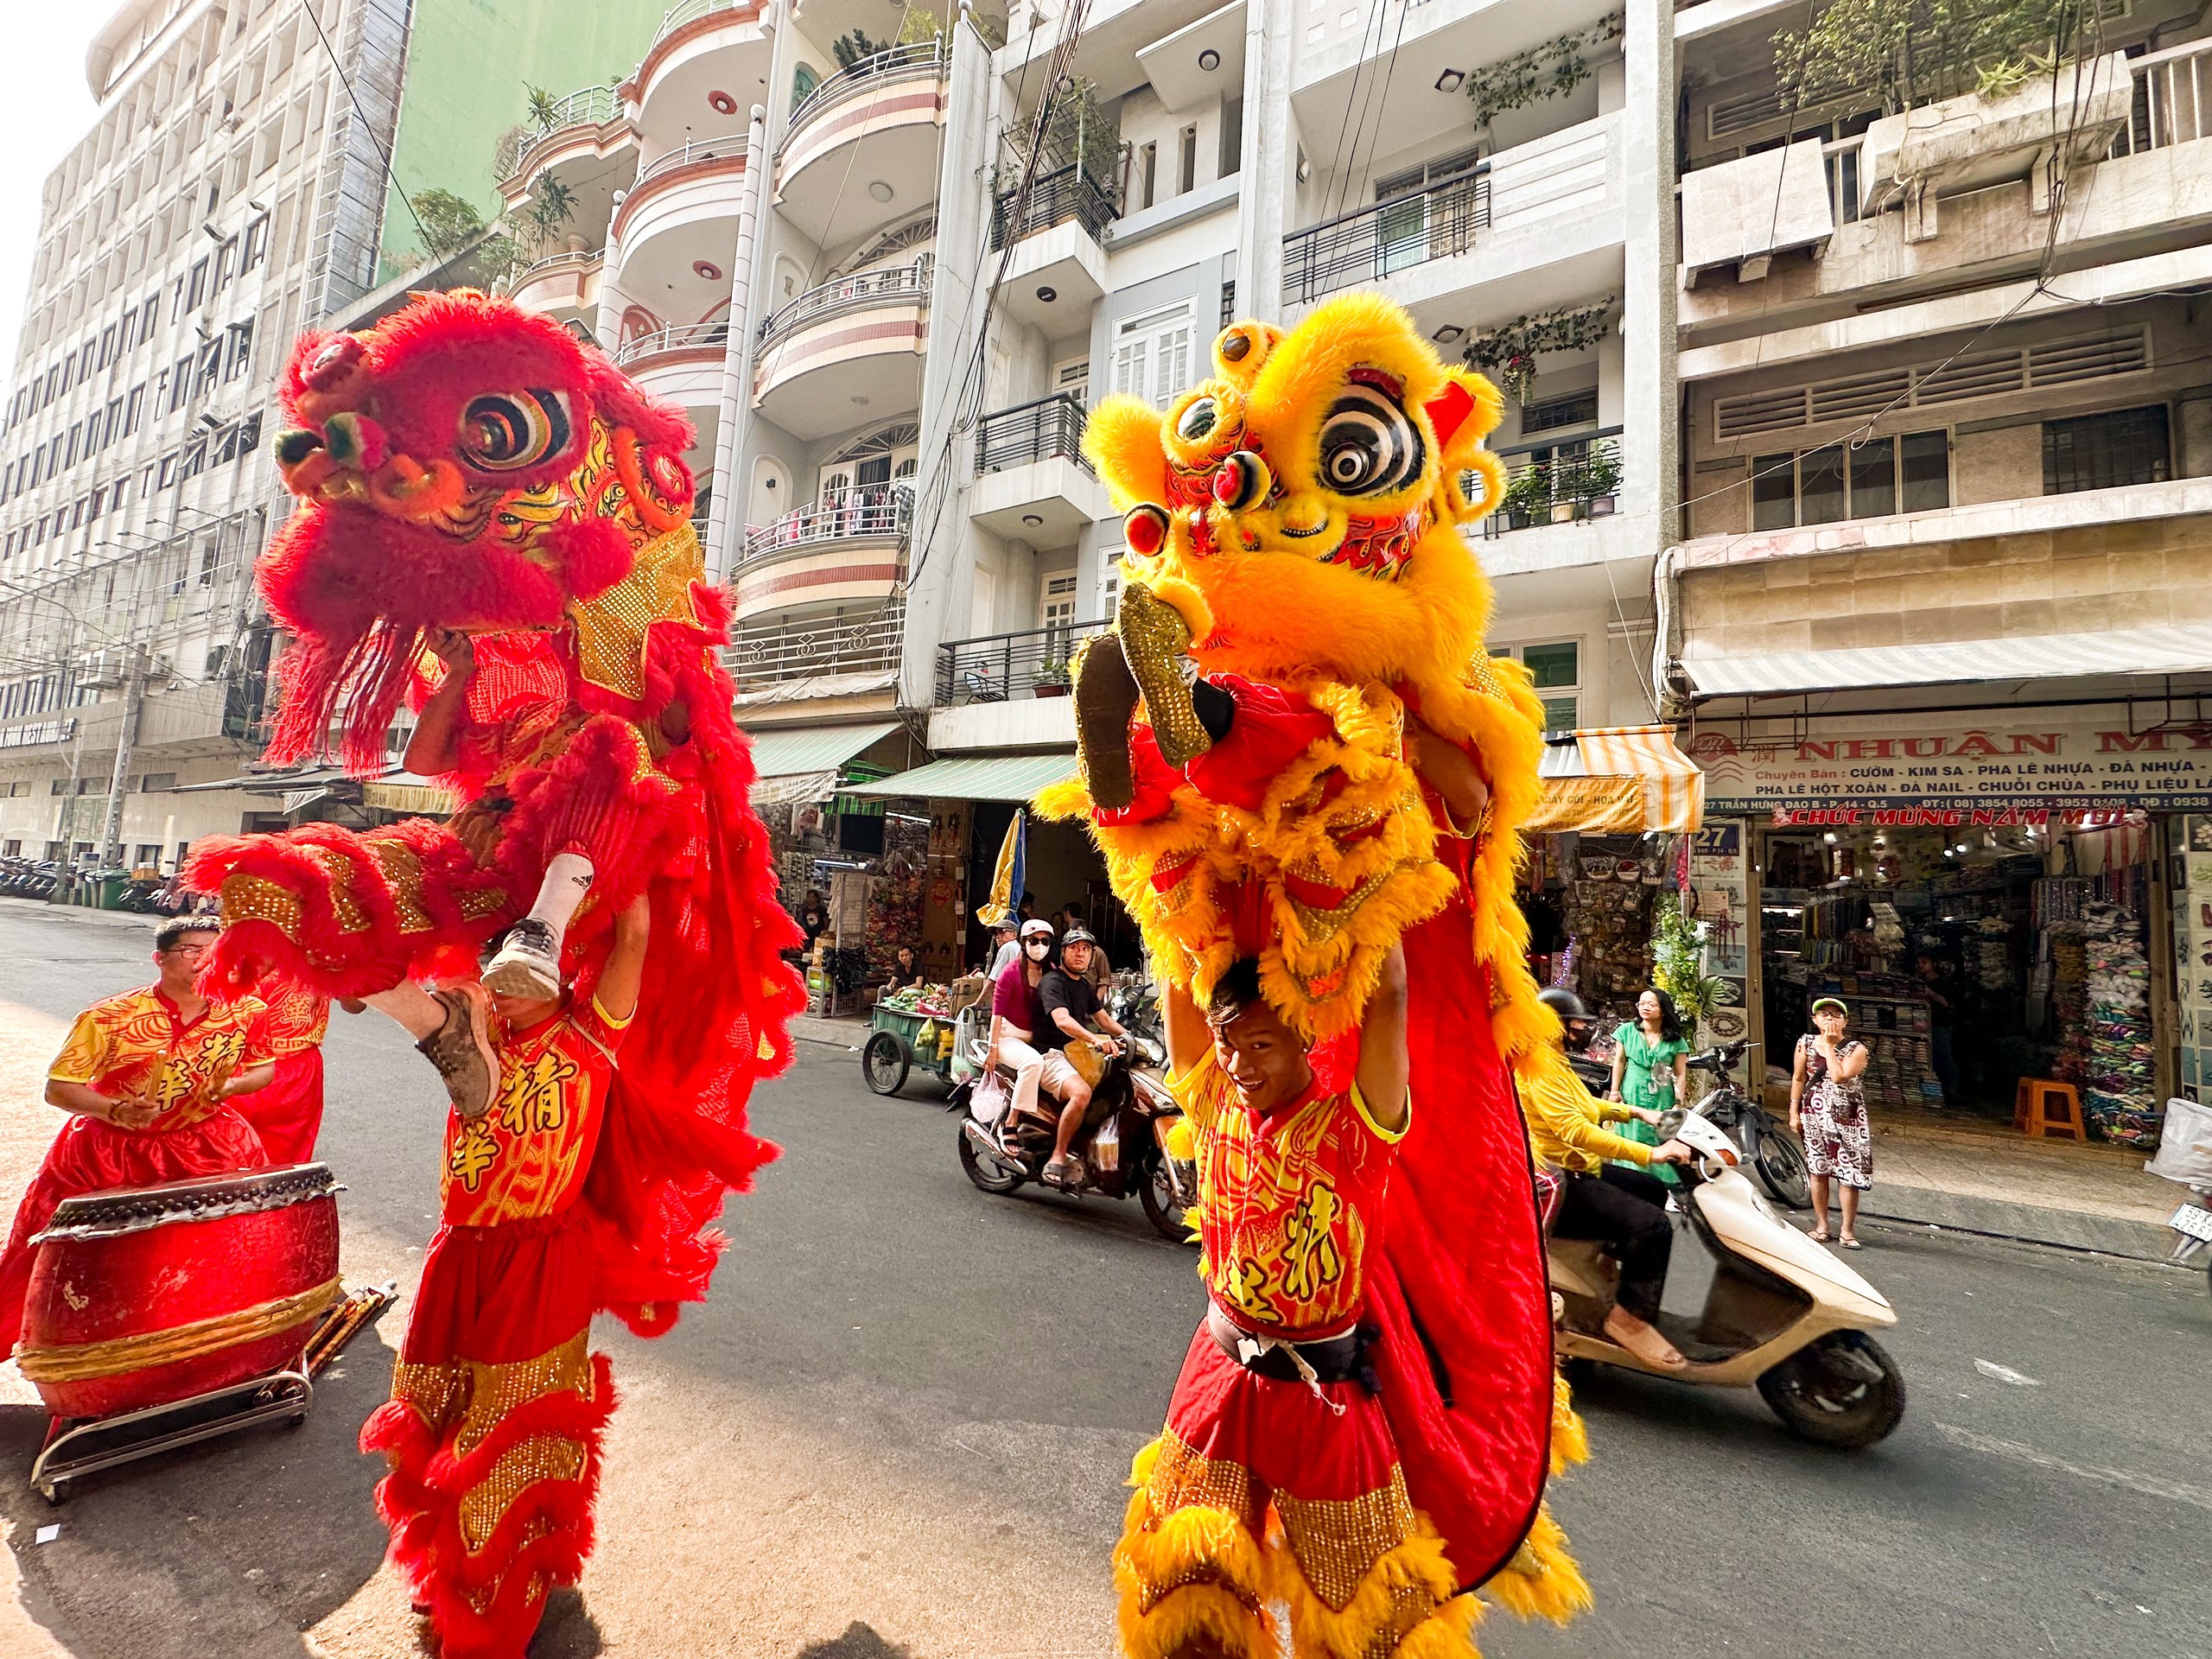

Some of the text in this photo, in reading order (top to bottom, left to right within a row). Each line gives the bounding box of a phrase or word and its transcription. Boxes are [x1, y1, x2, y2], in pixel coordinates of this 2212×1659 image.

[1794, 729, 2064, 762] NHUẬN
[1755, 770, 1806, 781] Chuyên
[1810, 769, 1837, 779] Bán
[1850, 766, 1894, 778] CƯỜM
[1908, 766, 1937, 777] KIM
[1942, 766, 1963, 776] SA
[1978, 765, 2012, 775] PHA
[2018, 761, 2037, 774] LÊ
[2044, 761, 2094, 776] NHỰA
[2109, 760, 2134, 772] ĐÁ
[2141, 760, 2195, 774] NHỰA
[1756, 785, 1783, 795] PHA
[1789, 783, 1805, 794] LÊ
[1810, 783, 1840, 796] HỘT
[1845, 782, 1886, 793] XOÀN
[1900, 781, 1922, 792] ĐÁ
[1927, 782, 1964, 792] NAIL
[1978, 778, 2031, 792] CHUỖI
[2036, 779, 2086, 791] CHÙA
[2101, 779, 2139, 792] PHỤ
[2145, 777, 2188, 792] LIỆU
[1593, 796, 1614, 804] HOA
[1718, 798, 1748, 810] TRẦN
[1811, 800, 1820, 809] B
[1867, 800, 1887, 809] Q.5
[1977, 798, 2008, 808] 3854
[2012, 798, 2044, 808] 8055
[2056, 798, 2089, 807] 3952
[2172, 797, 2209, 806] 0938
[1790, 802, 2127, 826] CHÚC MỪNG NĂM MỚI
[1696, 827, 1726, 847] 27
